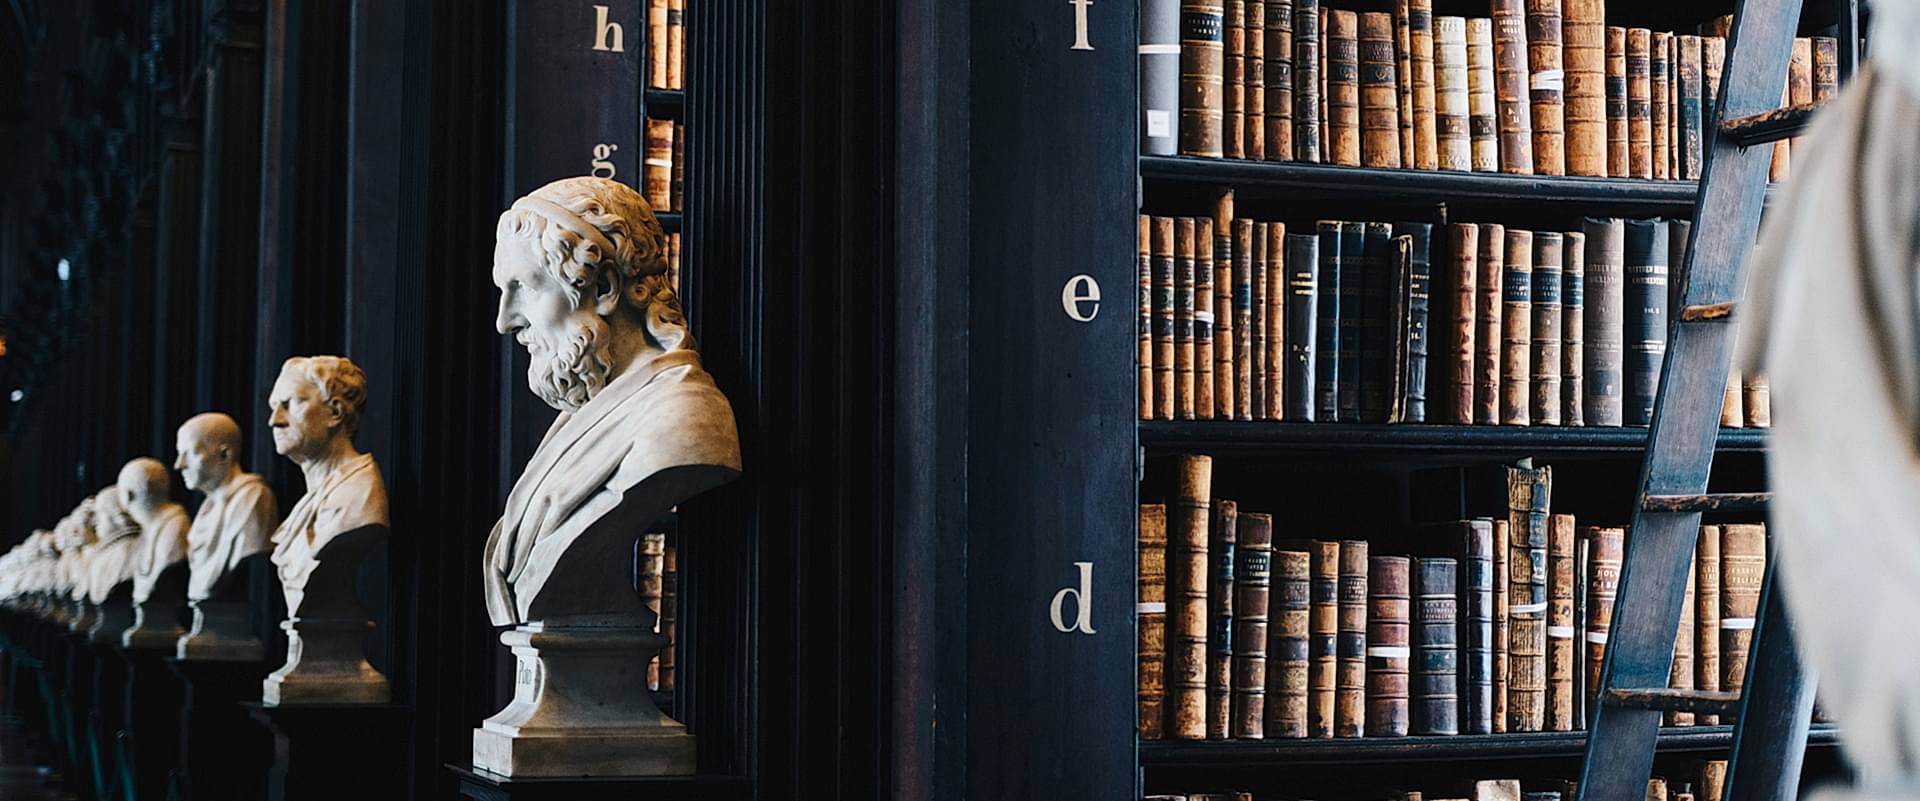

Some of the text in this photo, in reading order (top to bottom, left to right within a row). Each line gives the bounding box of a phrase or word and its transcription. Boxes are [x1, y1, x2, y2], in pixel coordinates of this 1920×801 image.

[592, 5, 625, 53] h
[591, 142, 618, 180] g
[1062, 274, 1101, 322] e
[1050, 562, 1096, 634] d
